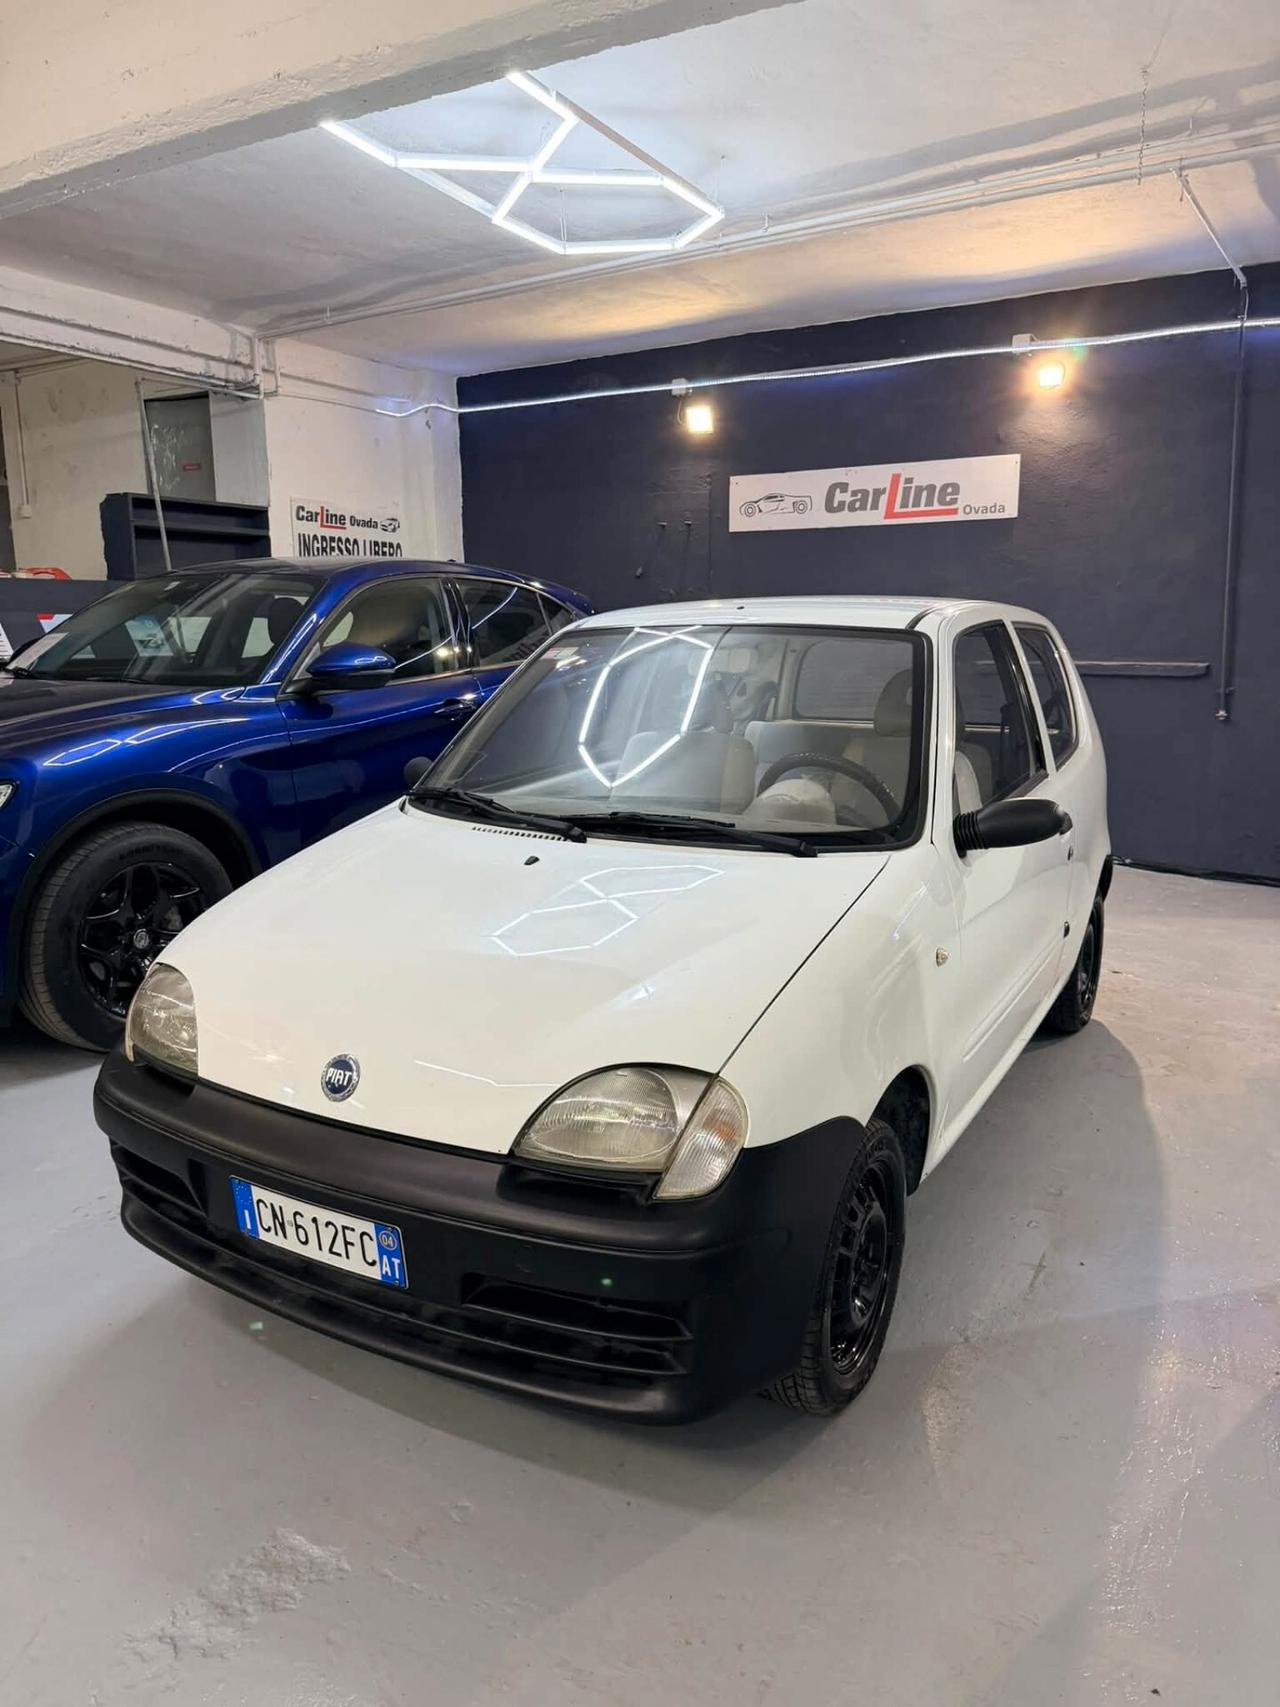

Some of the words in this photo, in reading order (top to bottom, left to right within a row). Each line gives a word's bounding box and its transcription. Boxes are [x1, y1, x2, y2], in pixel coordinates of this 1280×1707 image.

[824, 473, 960, 520] CarLine
[962, 501, 1005, 515] Ovada
[296, 505, 346, 530] CarLine
[349, 515, 378, 529] Ovada
[298, 532, 360, 557] INGRESSO
[381, 1234, 394, 1248] 04
[382, 1255, 401, 1279] AT
